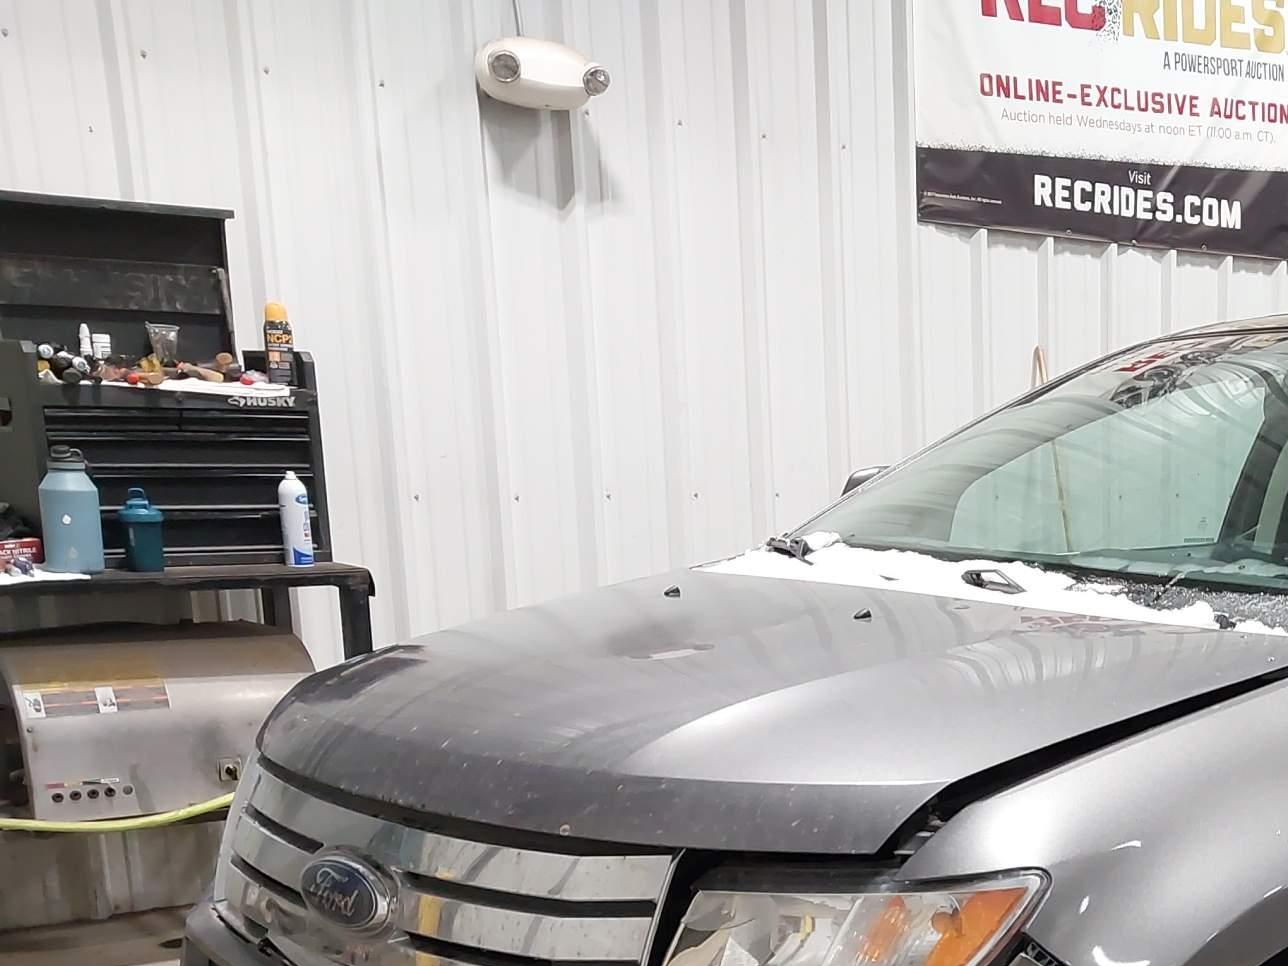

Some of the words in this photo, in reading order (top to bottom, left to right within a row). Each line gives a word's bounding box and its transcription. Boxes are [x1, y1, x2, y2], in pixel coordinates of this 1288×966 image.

[1163, 51, 1171, 70] A
[1174, 52, 1244, 78] POWERSPORT
[1245, 60, 1285, 82] AUCTION
[979, 72, 1200, 118] ONLINE-EXCLUSIVE
[1001, 108, 1045, 124] Auction
[1048, 112, 1073, 127] held
[1076, 114, 1142, 134] Wednesdays
[1144, 124, 1155, 134] at
[1158, 125, 1185, 136] noon
[1188, 125, 1203, 137] ET
[1128, 169, 1152, 186] Visit
[1033, 174, 1242, 230] RECRIDES.COM
[246, 396, 297, 408] HUSKY
